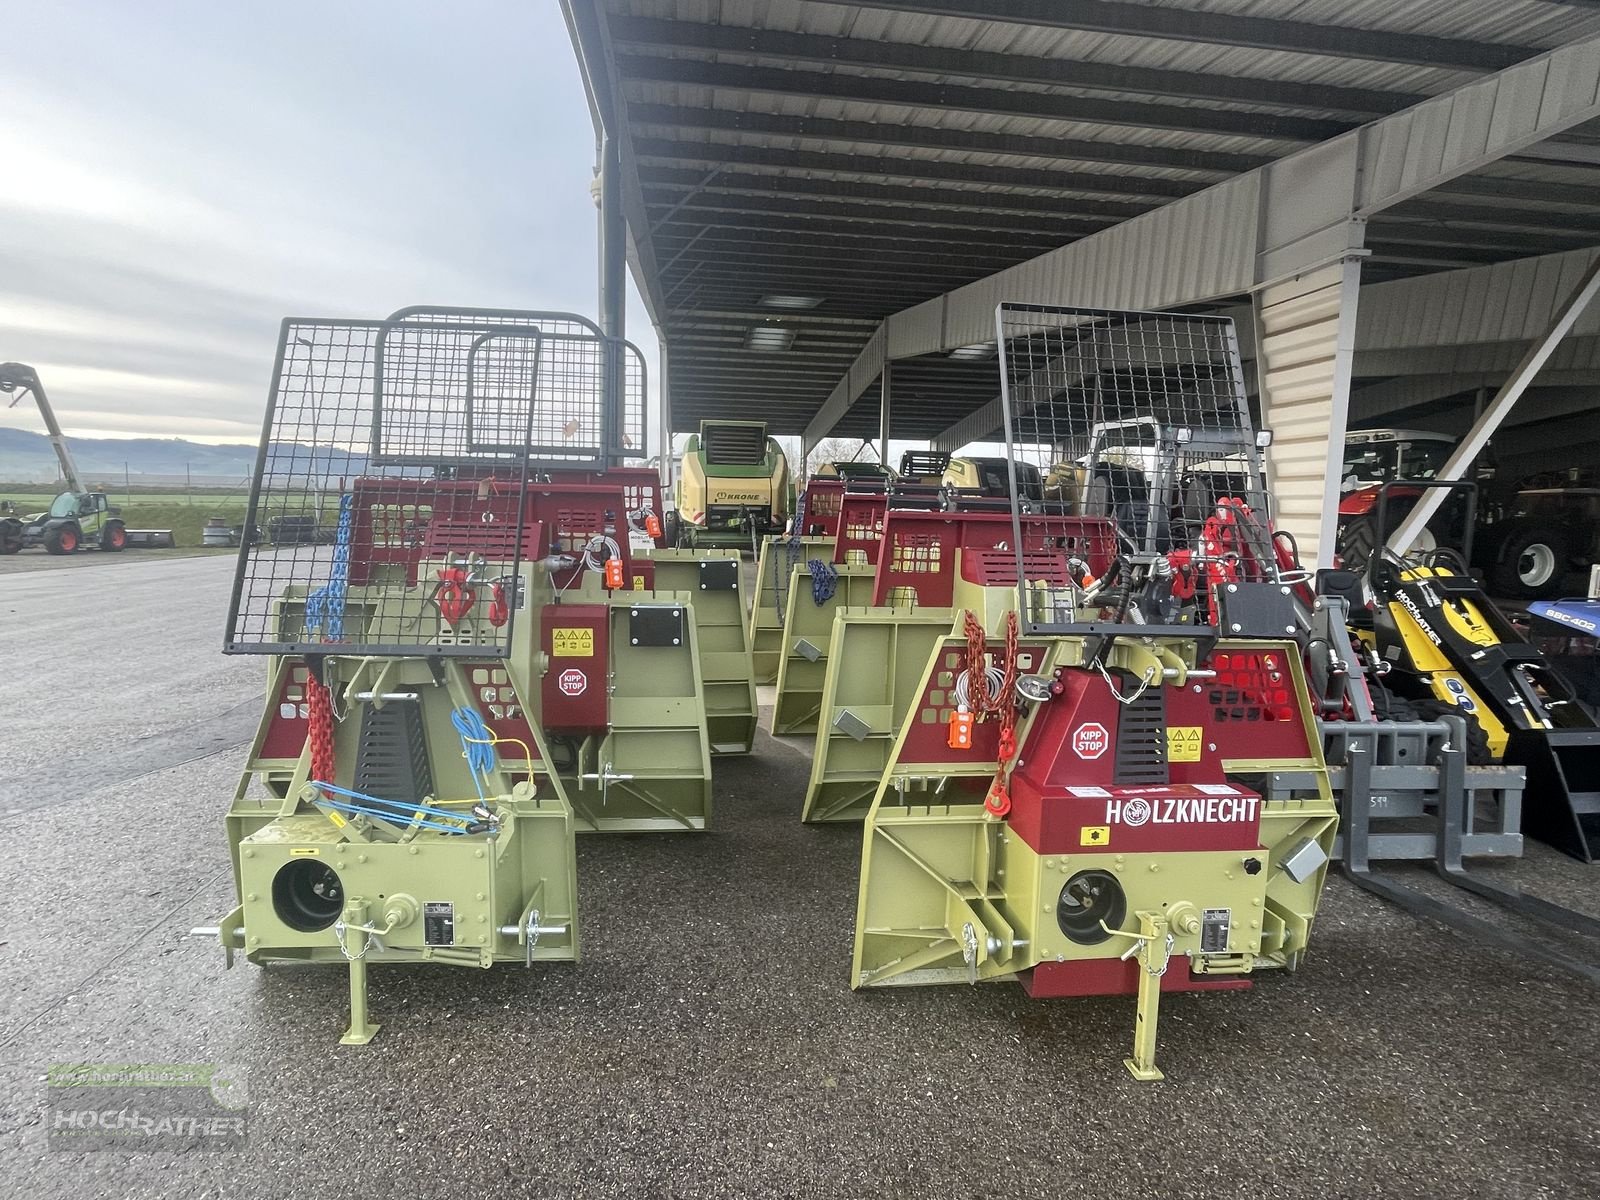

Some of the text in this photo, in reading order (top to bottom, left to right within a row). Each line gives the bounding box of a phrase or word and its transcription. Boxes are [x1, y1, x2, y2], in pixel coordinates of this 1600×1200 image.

[1395, 589, 1442, 646] HOCHRATHER
[1546, 609, 1596, 631] SBC 402
[1078, 741, 1103, 751] STOP
[1080, 731, 1102, 741] KIPP
[1105, 798, 1259, 827] HOLZKNECHT
